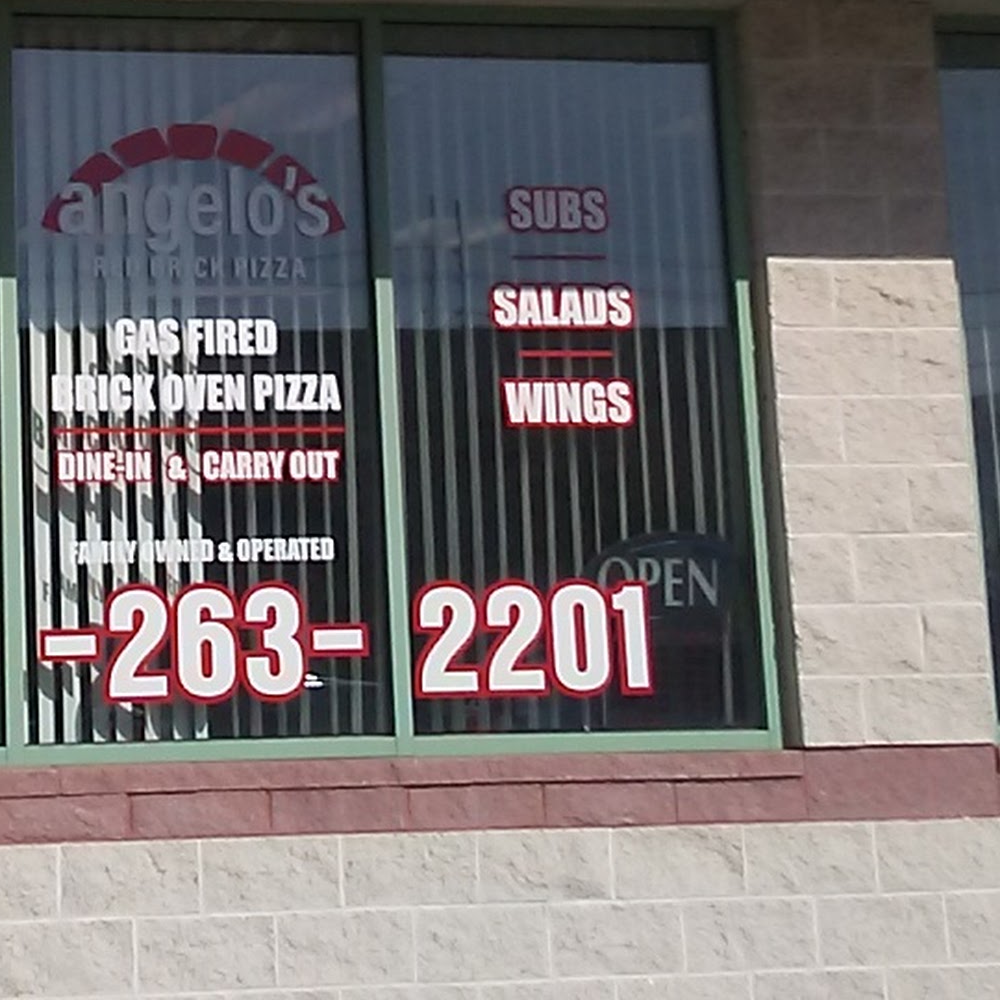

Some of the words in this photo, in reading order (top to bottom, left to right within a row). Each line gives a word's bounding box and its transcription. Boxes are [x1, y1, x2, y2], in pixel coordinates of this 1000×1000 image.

[57, 165, 330, 252] angelo's
[508, 187, 607, 232] SUBS
[234, 257, 306, 279] PIZZA
[491, 285, 634, 329] SALADS
[115, 318, 181, 356] GAS
[187, 318, 278, 356] FIRED
[51, 374, 156, 412] BRICK
[160, 374, 246, 411] OVEN
[253, 374, 342, 411] PIZZA
[502, 378, 635, 428] WINGS
[58, 450, 152, 482] DINE-IN
[167, 454, 189, 482] &
[202, 450, 285, 481] CARRY
[289, 450, 340, 480] OUT
[218, 541, 234, 562] &
[237, 537, 335, 562] OPERATED
[597, 557, 719, 606] OPEN
[414, 577, 653, 698] 2201
